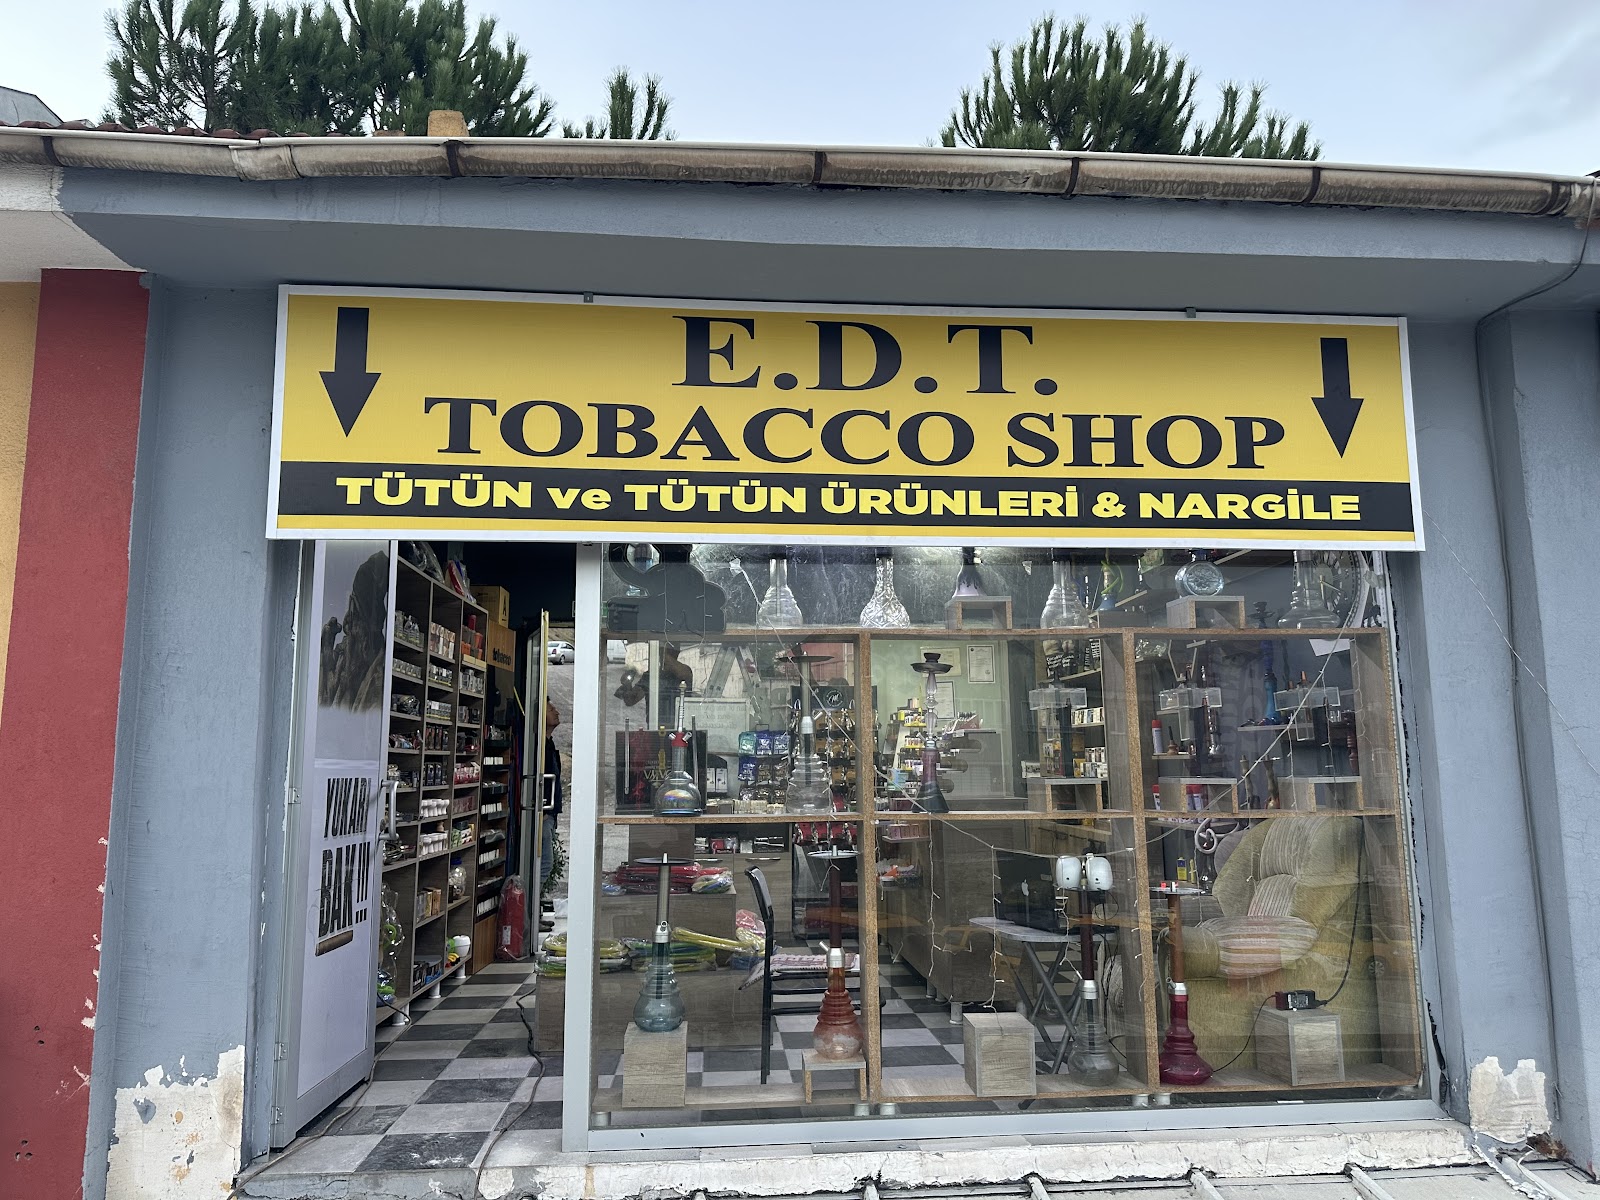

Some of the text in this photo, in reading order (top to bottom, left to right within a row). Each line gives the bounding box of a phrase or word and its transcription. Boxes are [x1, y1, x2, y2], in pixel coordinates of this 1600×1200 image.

[672, 316, 1058, 395] E.D.T.
[424, 397, 1284, 469] TOBACCO SHOP
[336, 472, 1361, 521] TÜTÜN ve TÜTÜN ÜRÜNLERİ & NARGİLE
[324, 778, 371, 839] YUKARI
